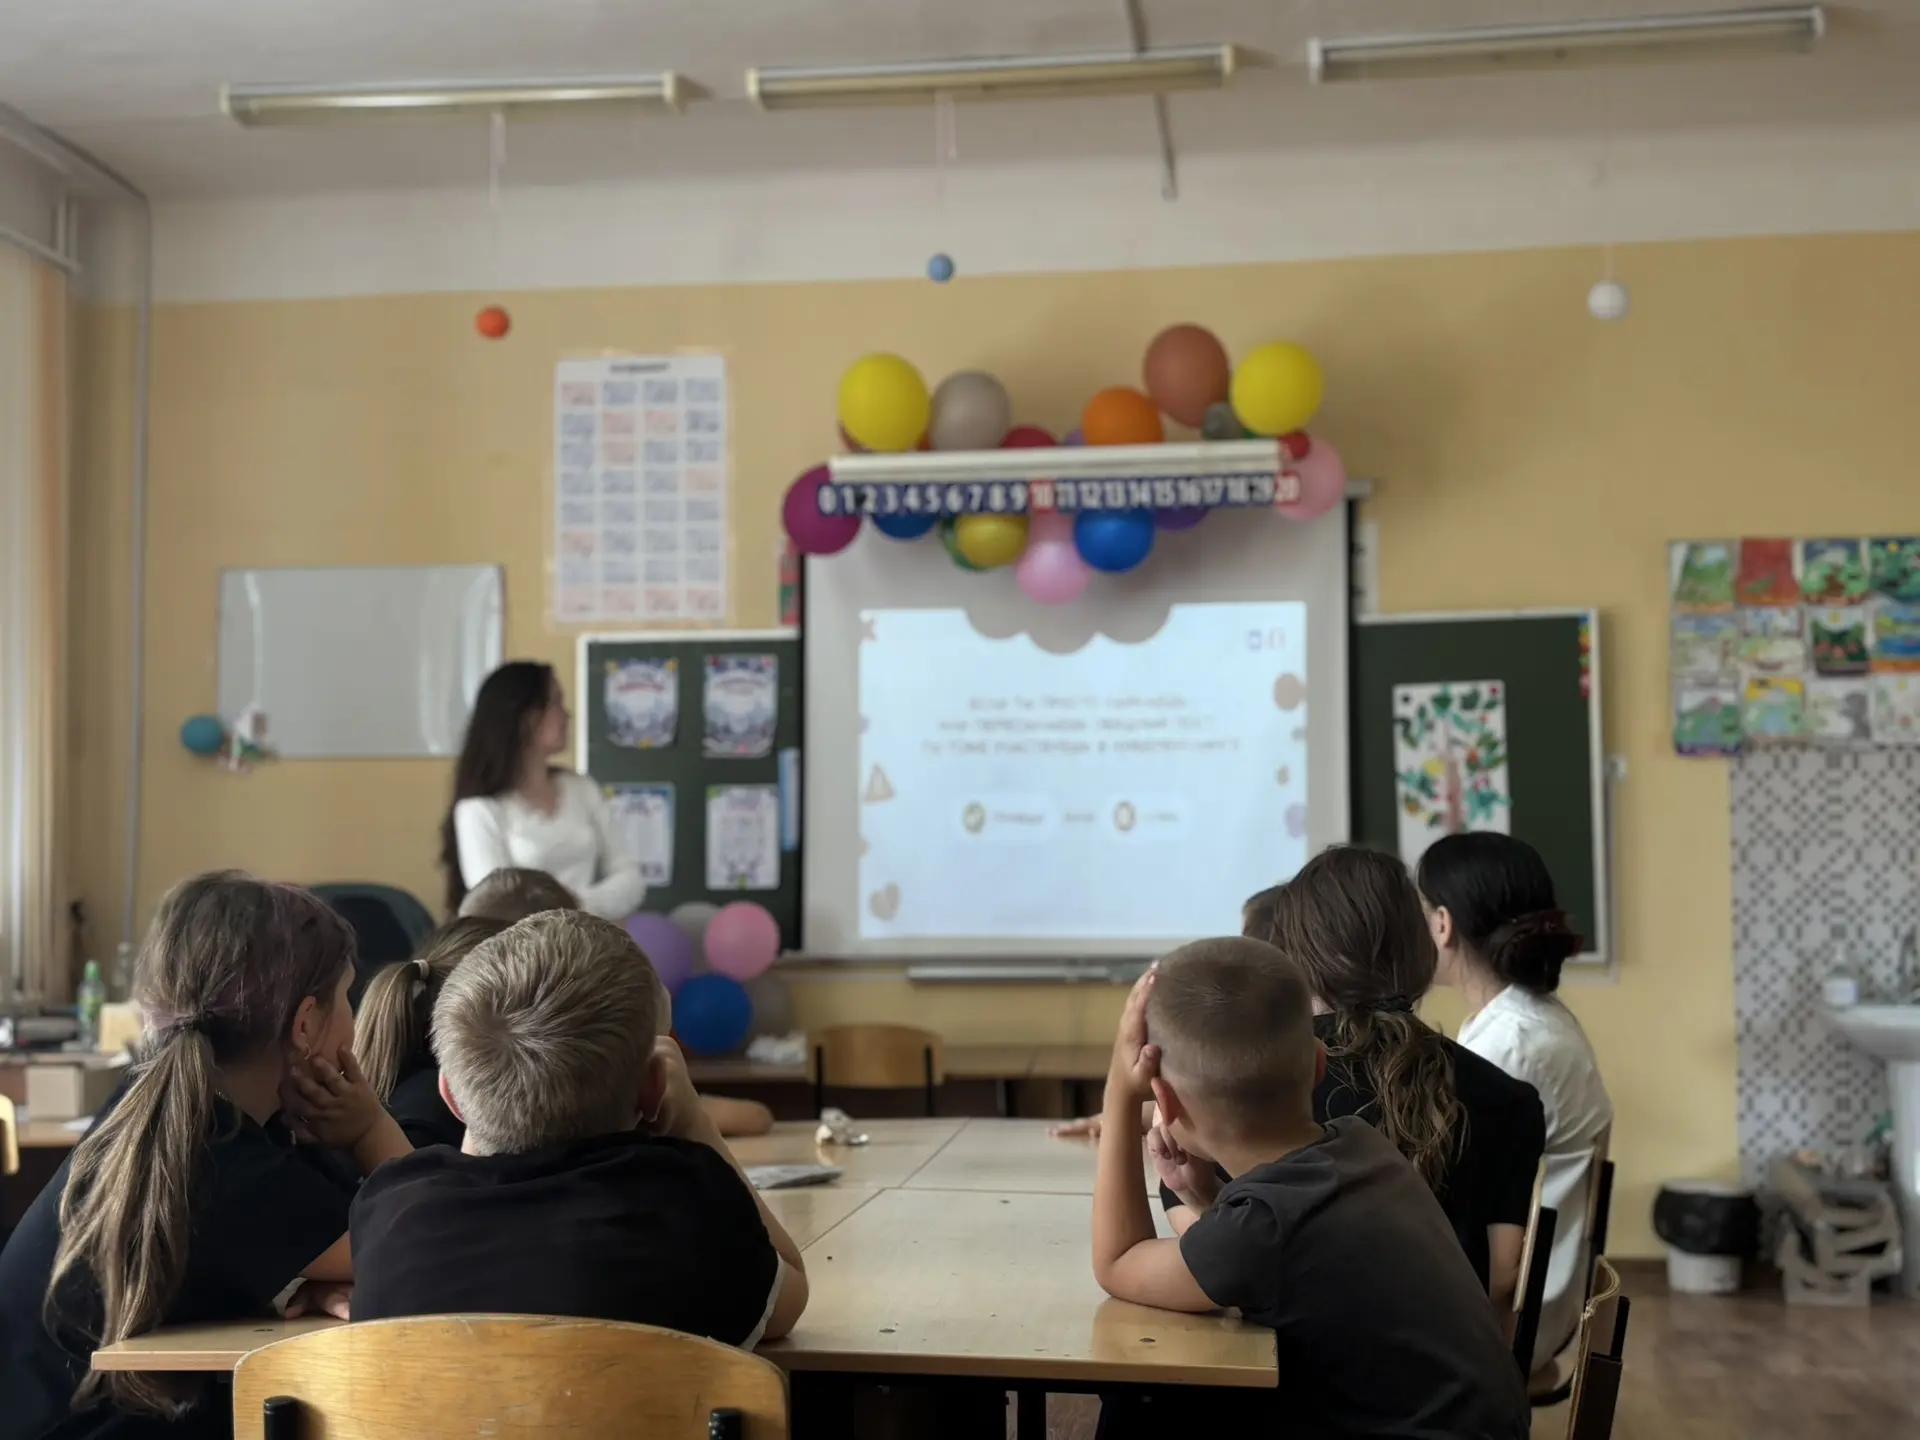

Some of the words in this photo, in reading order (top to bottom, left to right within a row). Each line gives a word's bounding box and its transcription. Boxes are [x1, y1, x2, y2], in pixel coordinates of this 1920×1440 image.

[818, 485, 837, 514] 0
[842, 485, 855, 514] 1
[863, 484, 877, 512] 2
[884, 484, 899, 513] 3
[903, 484, 920, 512] 4
[925, 484, 941, 512] 5
[946, 484, 963, 512] 6
[967, 483, 983, 511] 7
[989, 483, 1006, 512] 8
[1010, 482, 1028, 511] 9
